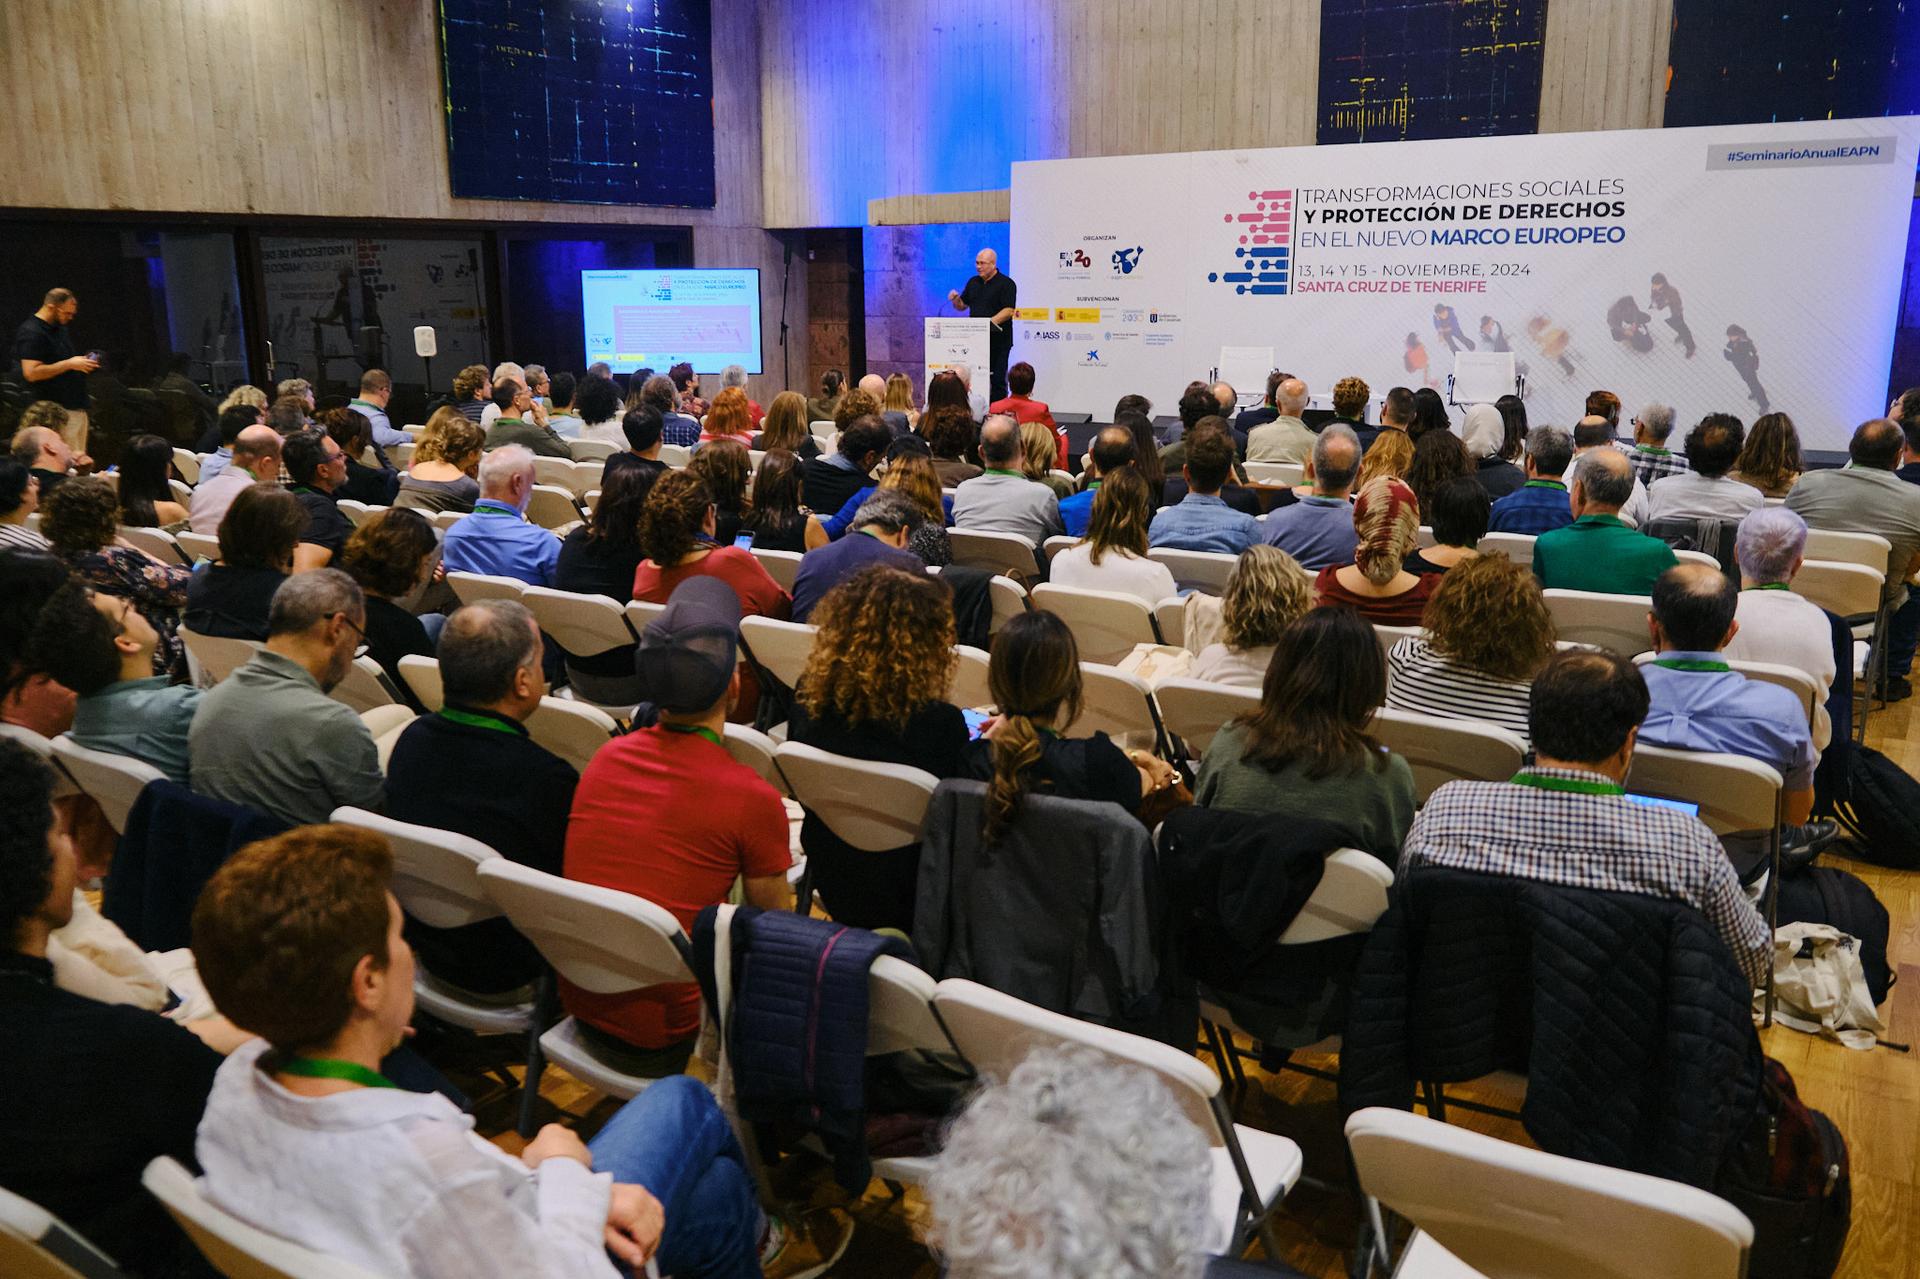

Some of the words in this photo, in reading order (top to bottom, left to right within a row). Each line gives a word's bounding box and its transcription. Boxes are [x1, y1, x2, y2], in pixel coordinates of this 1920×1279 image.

[1727, 145, 1880, 162] #SeminarioAnualEAPN
[1303, 182, 1513, 204] TRANSFORMACIONES
[1519, 178, 1625, 197] SOCIALES
[1304, 209, 1317, 224] Y
[1322, 202, 1456, 224] PROTECCIÓN
[1462, 204, 1492, 221] DE
[1499, 201, 1626, 220] DERECHOS
[1301, 231, 1327, 248] EN
[1331, 231, 1353, 247] EL
[1357, 229, 1427, 247] NUEVO
[1430, 228, 1510, 246] MARCO
[1514, 226, 1626, 245] EUROPEO
[1298, 264, 1315, 278] 13,
[1319, 264, 1335, 277] 14
[1339, 264, 1347, 276] Y
[1350, 264, 1367, 276] 15
[1382, 263, 1485, 278] NOVIEMBRE,
[1490, 263, 1531, 276] 2024
[1297, 281, 1345, 293] SANTA
[1348, 281, 1388, 293] CRUZ
[1391, 281, 1411, 293] DE
[1414, 280, 1487, 293] TENERIFE
